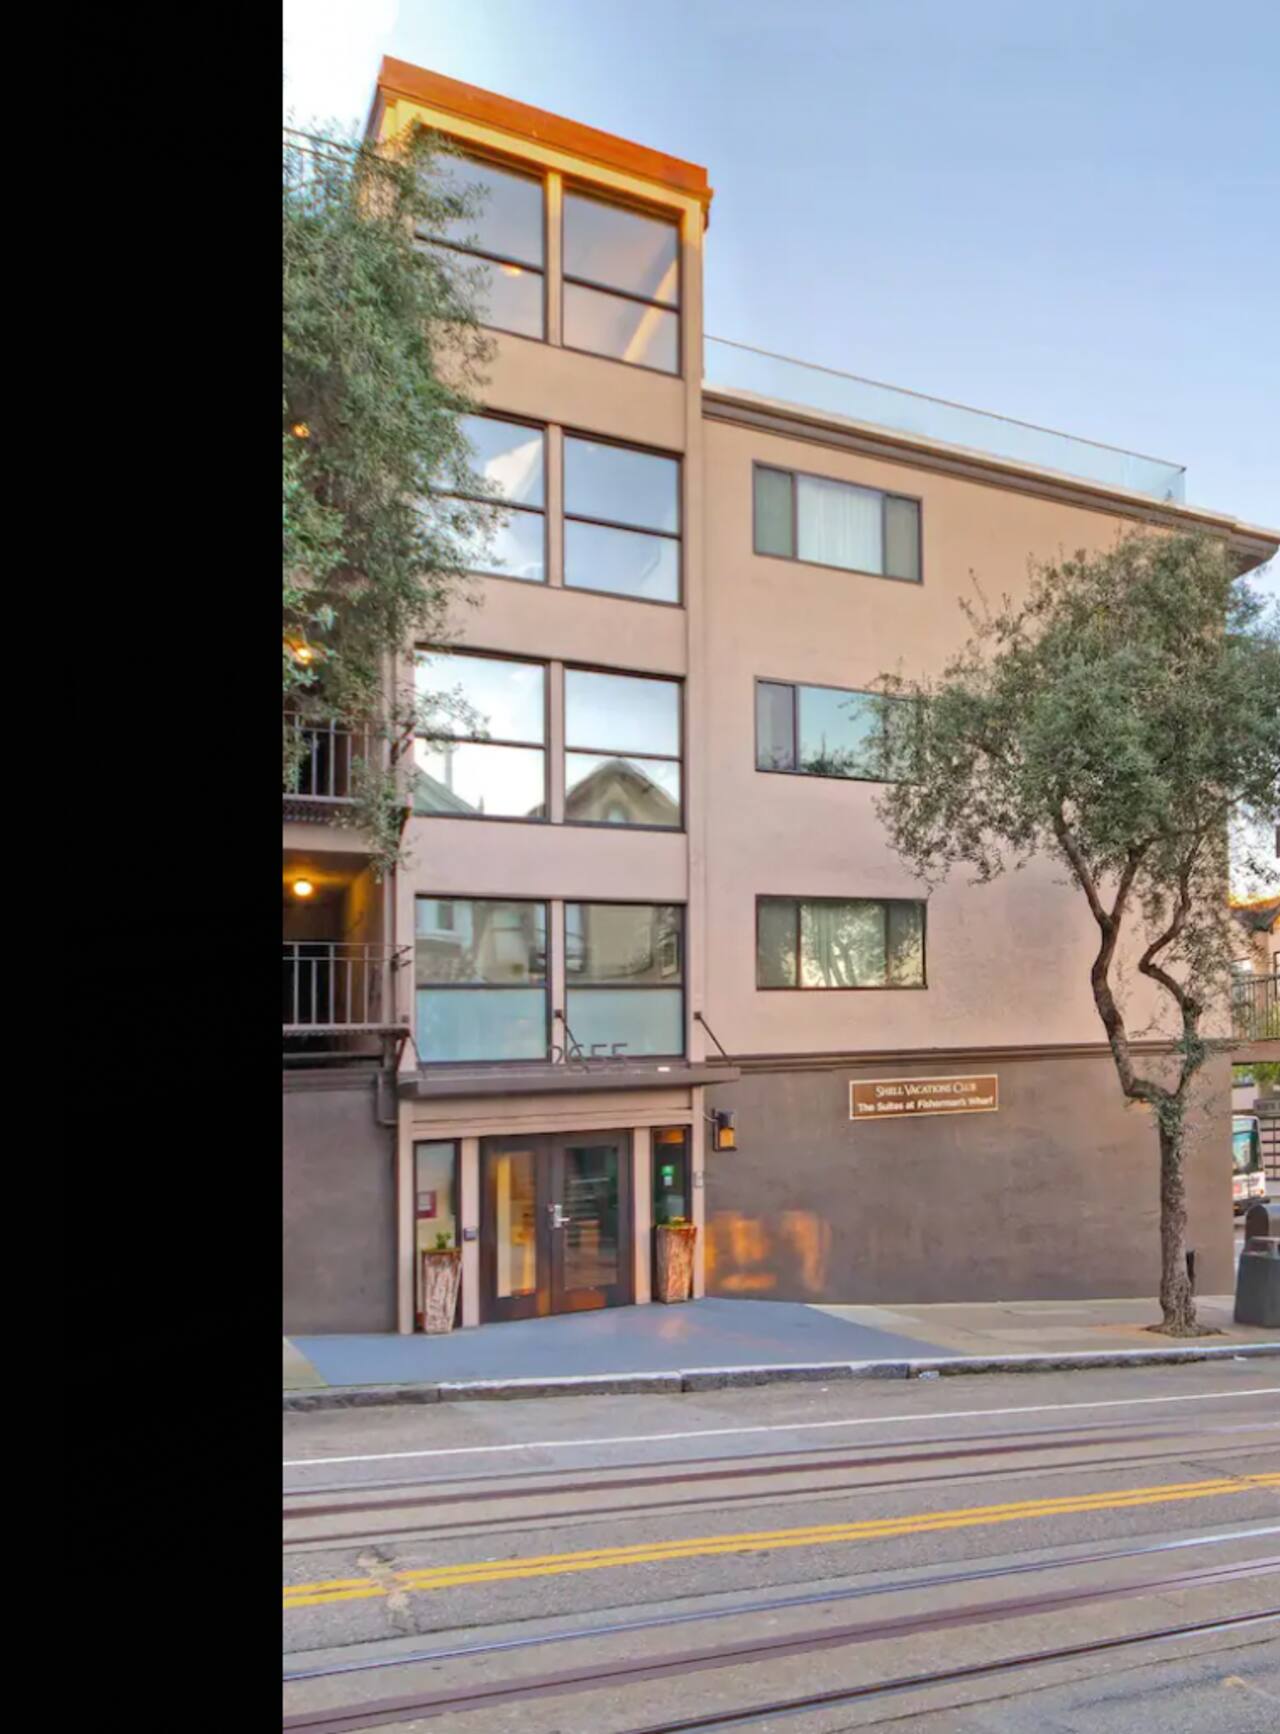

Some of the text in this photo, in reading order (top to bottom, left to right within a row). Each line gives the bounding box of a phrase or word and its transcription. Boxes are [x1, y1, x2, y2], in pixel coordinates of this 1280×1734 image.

[904, 1084, 951, 1096] VACATIONS
[858, 1103, 875, 1112] The
[877, 1101, 904, 1111] Suites
[906, 1101, 915, 1110] at
